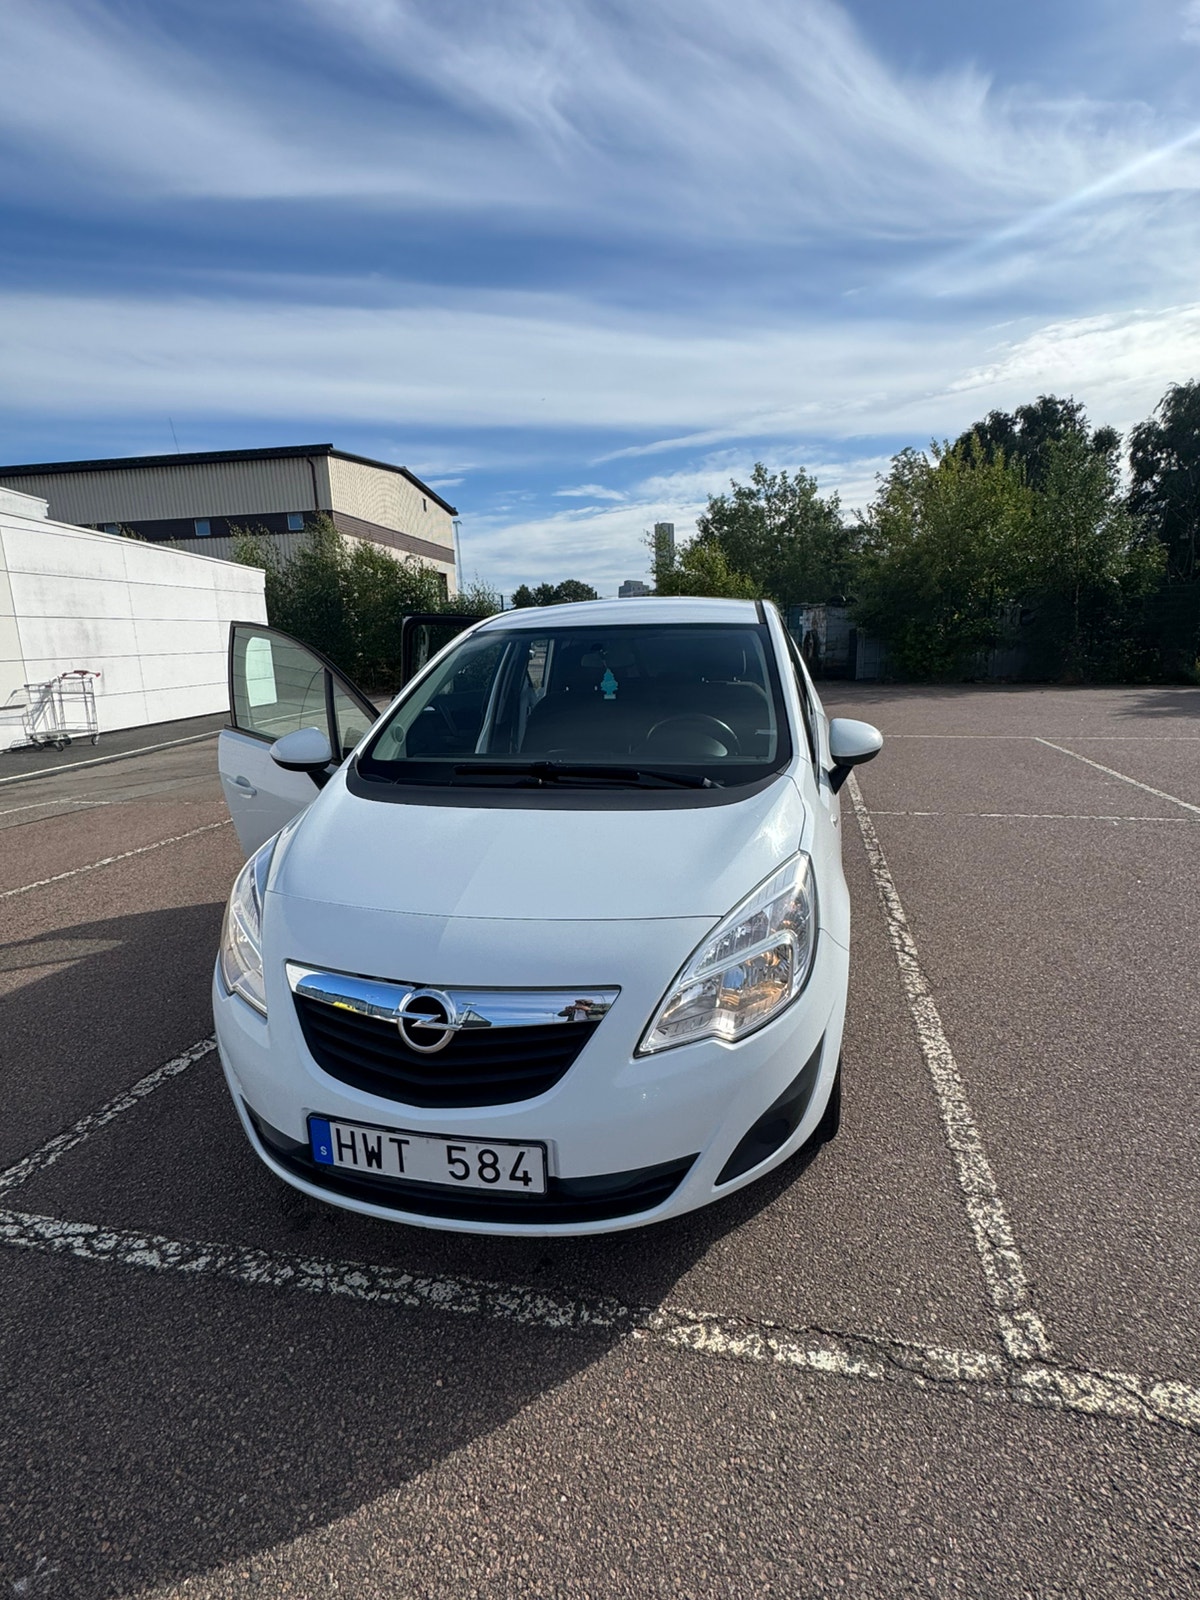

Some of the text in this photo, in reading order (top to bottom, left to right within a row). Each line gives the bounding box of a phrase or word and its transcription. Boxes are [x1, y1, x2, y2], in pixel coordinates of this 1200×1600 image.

[320, 1145, 328, 1156] S
[335, 1128, 533, 1187] HWT 584
